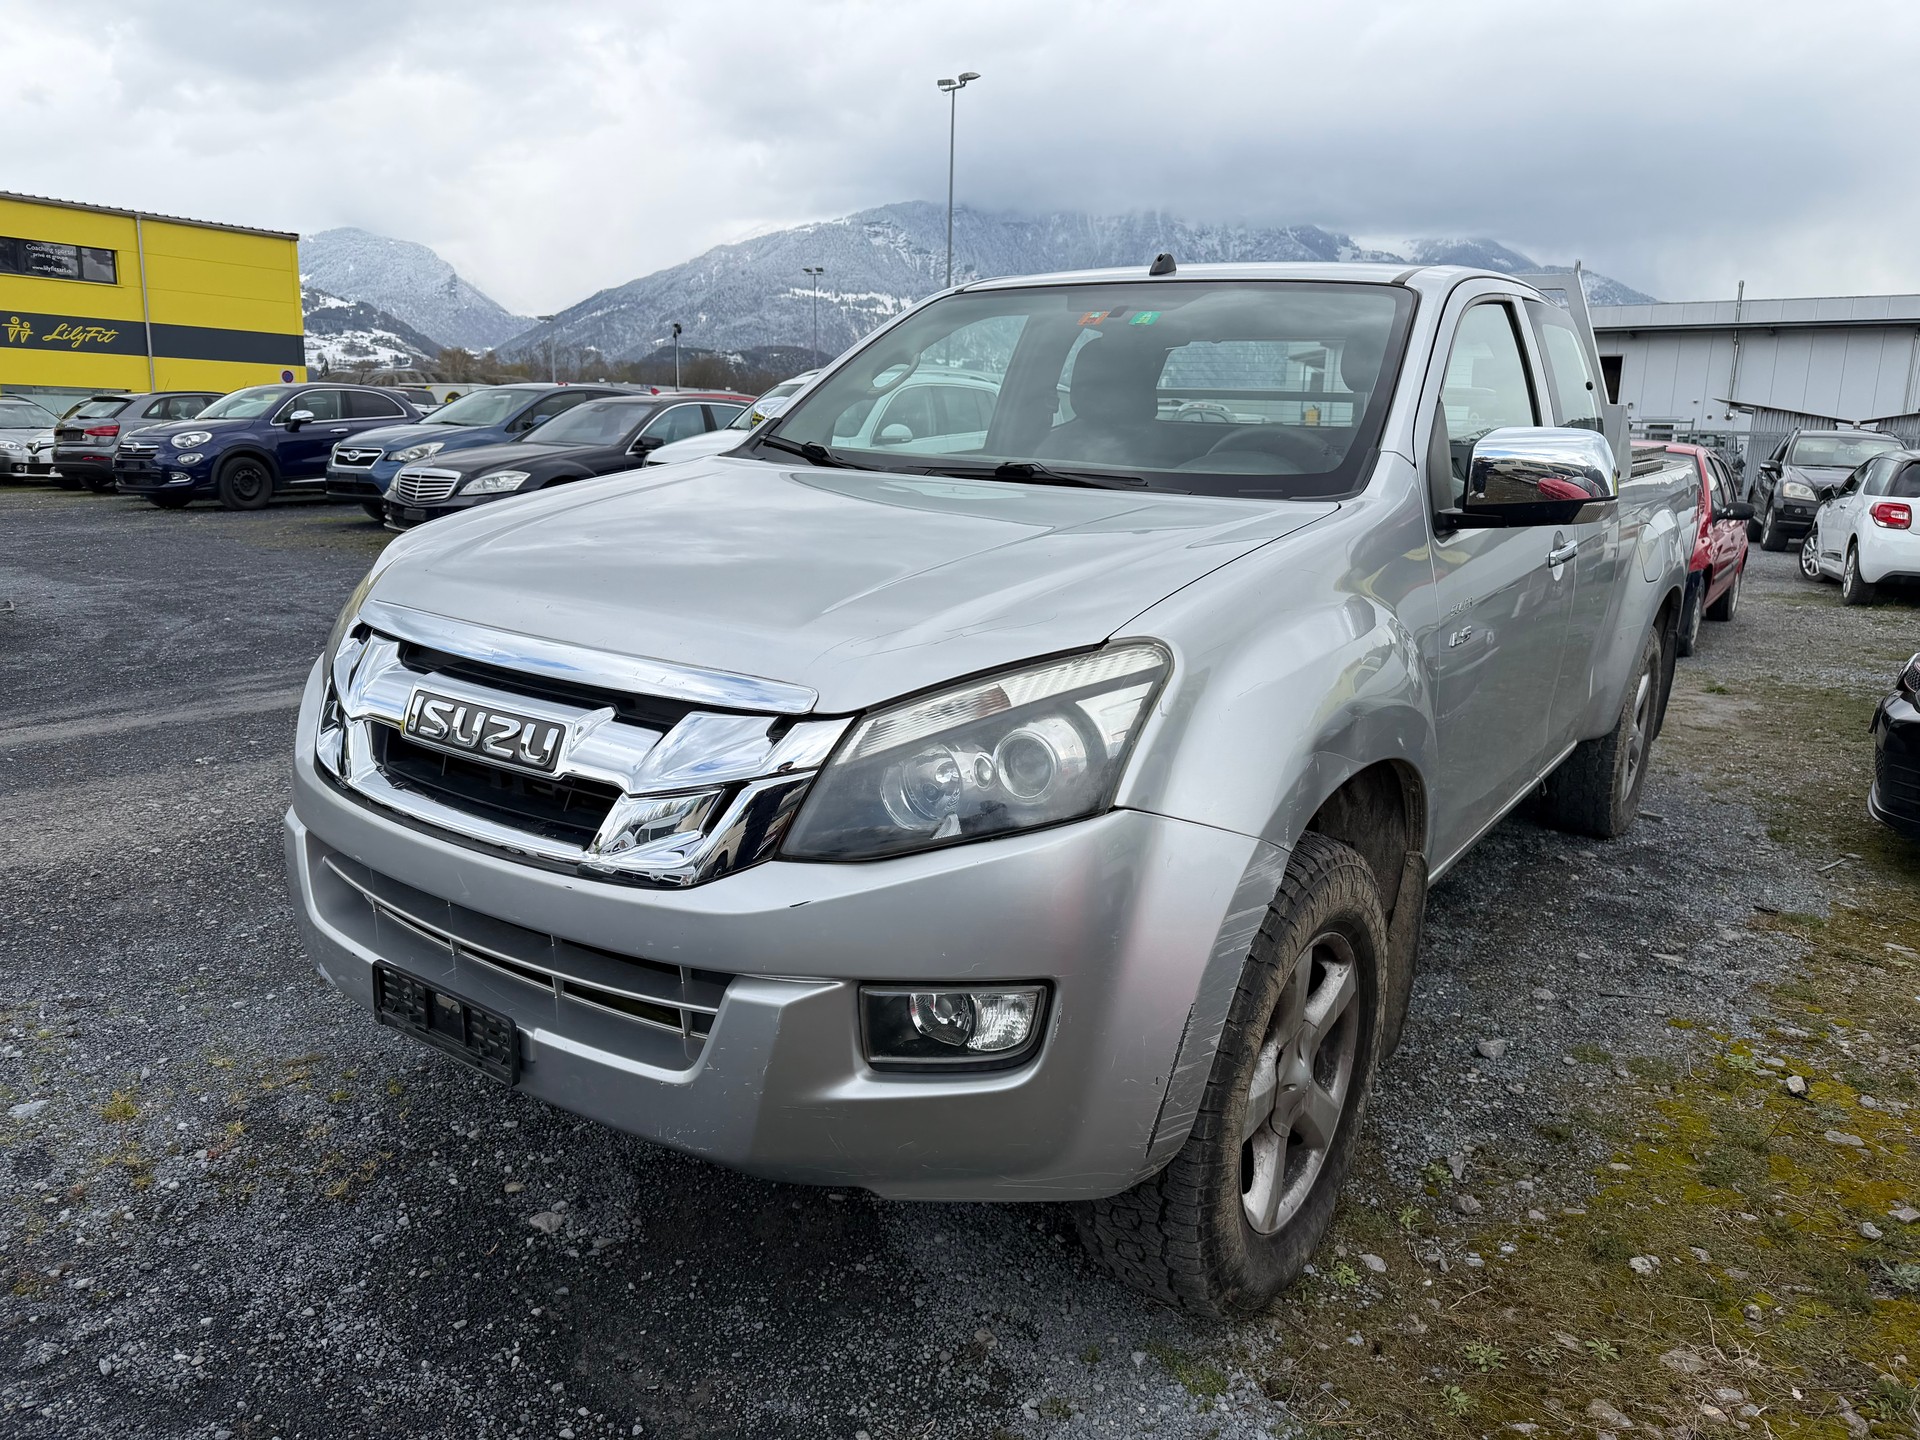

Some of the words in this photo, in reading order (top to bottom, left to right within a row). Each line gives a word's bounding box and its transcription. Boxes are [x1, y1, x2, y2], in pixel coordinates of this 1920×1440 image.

[26, 244, 53, 254] Coaching
[42, 323, 119, 348] LilyFit
[408, 695, 560, 766] ISUZU
